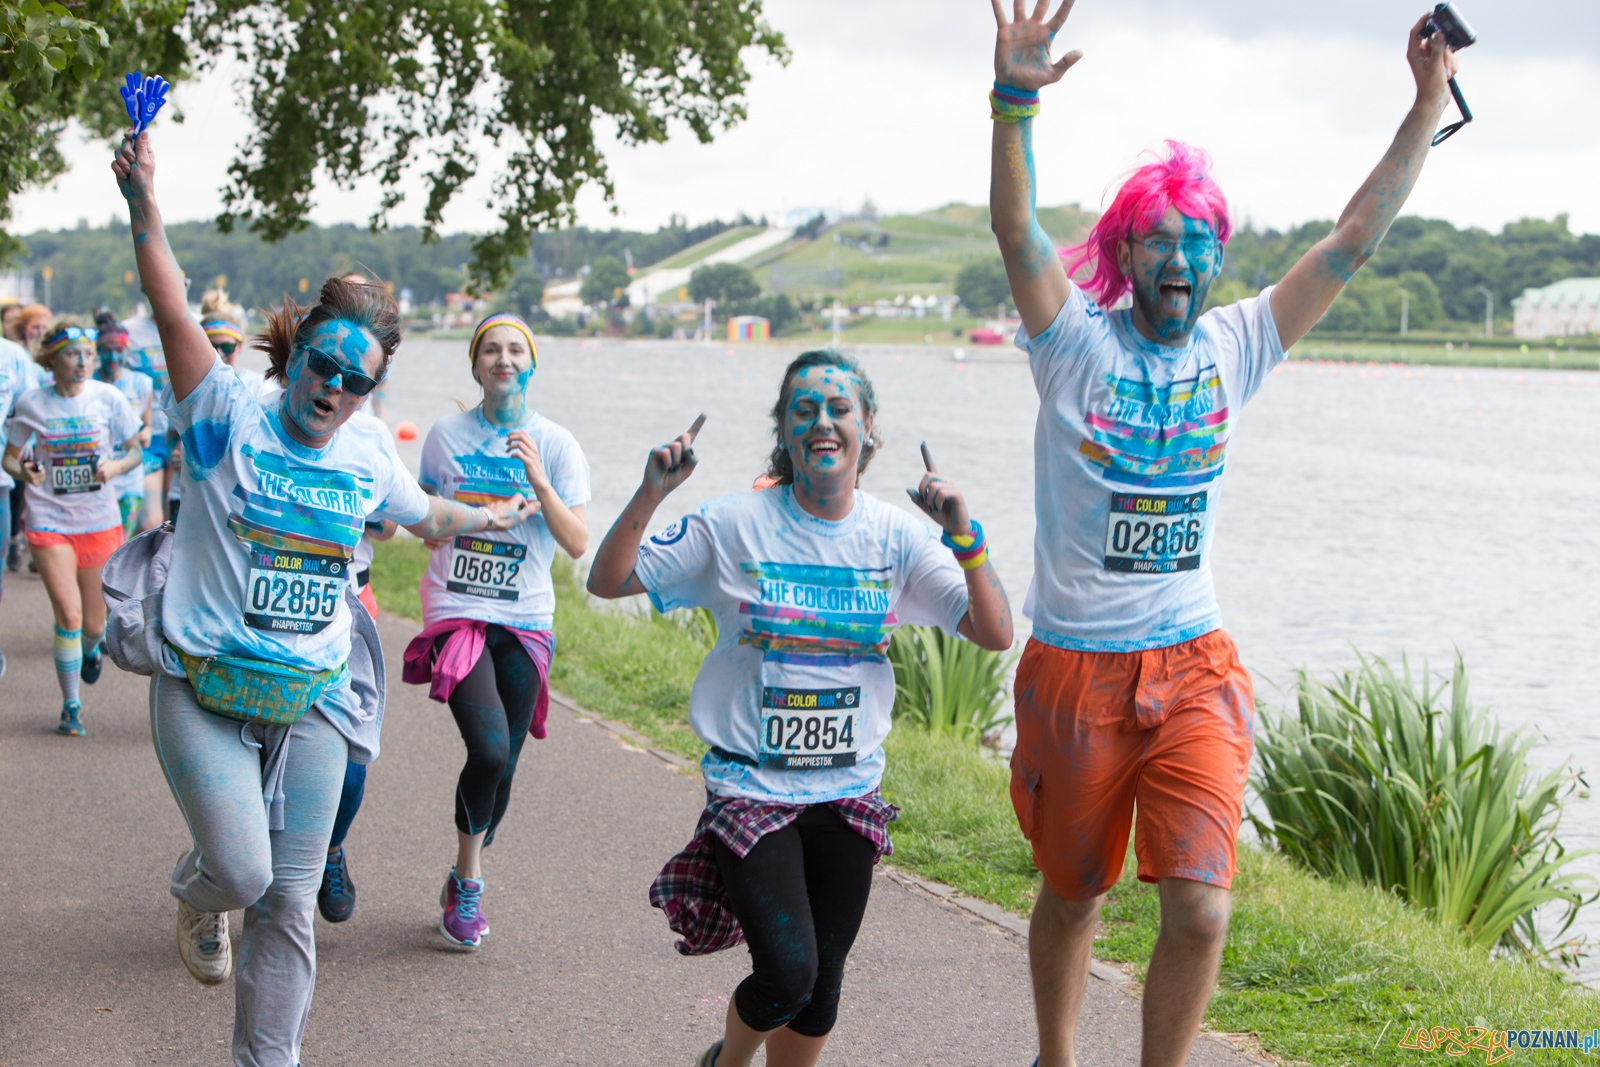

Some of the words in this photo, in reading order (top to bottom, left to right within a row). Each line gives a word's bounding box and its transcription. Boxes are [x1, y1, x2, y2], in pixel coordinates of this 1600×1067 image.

[257, 471, 287, 498] THE
[288, 482, 340, 510] COLOR
[1119, 497, 1136, 511] THE
[1136, 498, 1167, 513] COLOR
[459, 537, 471, 549] THE
[471, 540, 493, 554] COLOR
[492, 545, 506, 555] RUN
[1112, 520, 1201, 556] 02856
[258, 554, 274, 568] THE
[274, 555, 302, 570] COLOR
[302, 559, 320, 572] RUN
[453, 554, 520, 588] 05832
[252, 576, 338, 617] 02855
[758, 579, 790, 604] THE
[793, 584, 853, 611] COLOR
[856, 589, 889, 612] RUN
[770, 693, 787, 707] THE
[787, 693, 817, 708] COLOR
[817, 694, 835, 708] RUN
[766, 714, 854, 751] 02854
[787, 756, 833, 767] #HAPPIEST5K
